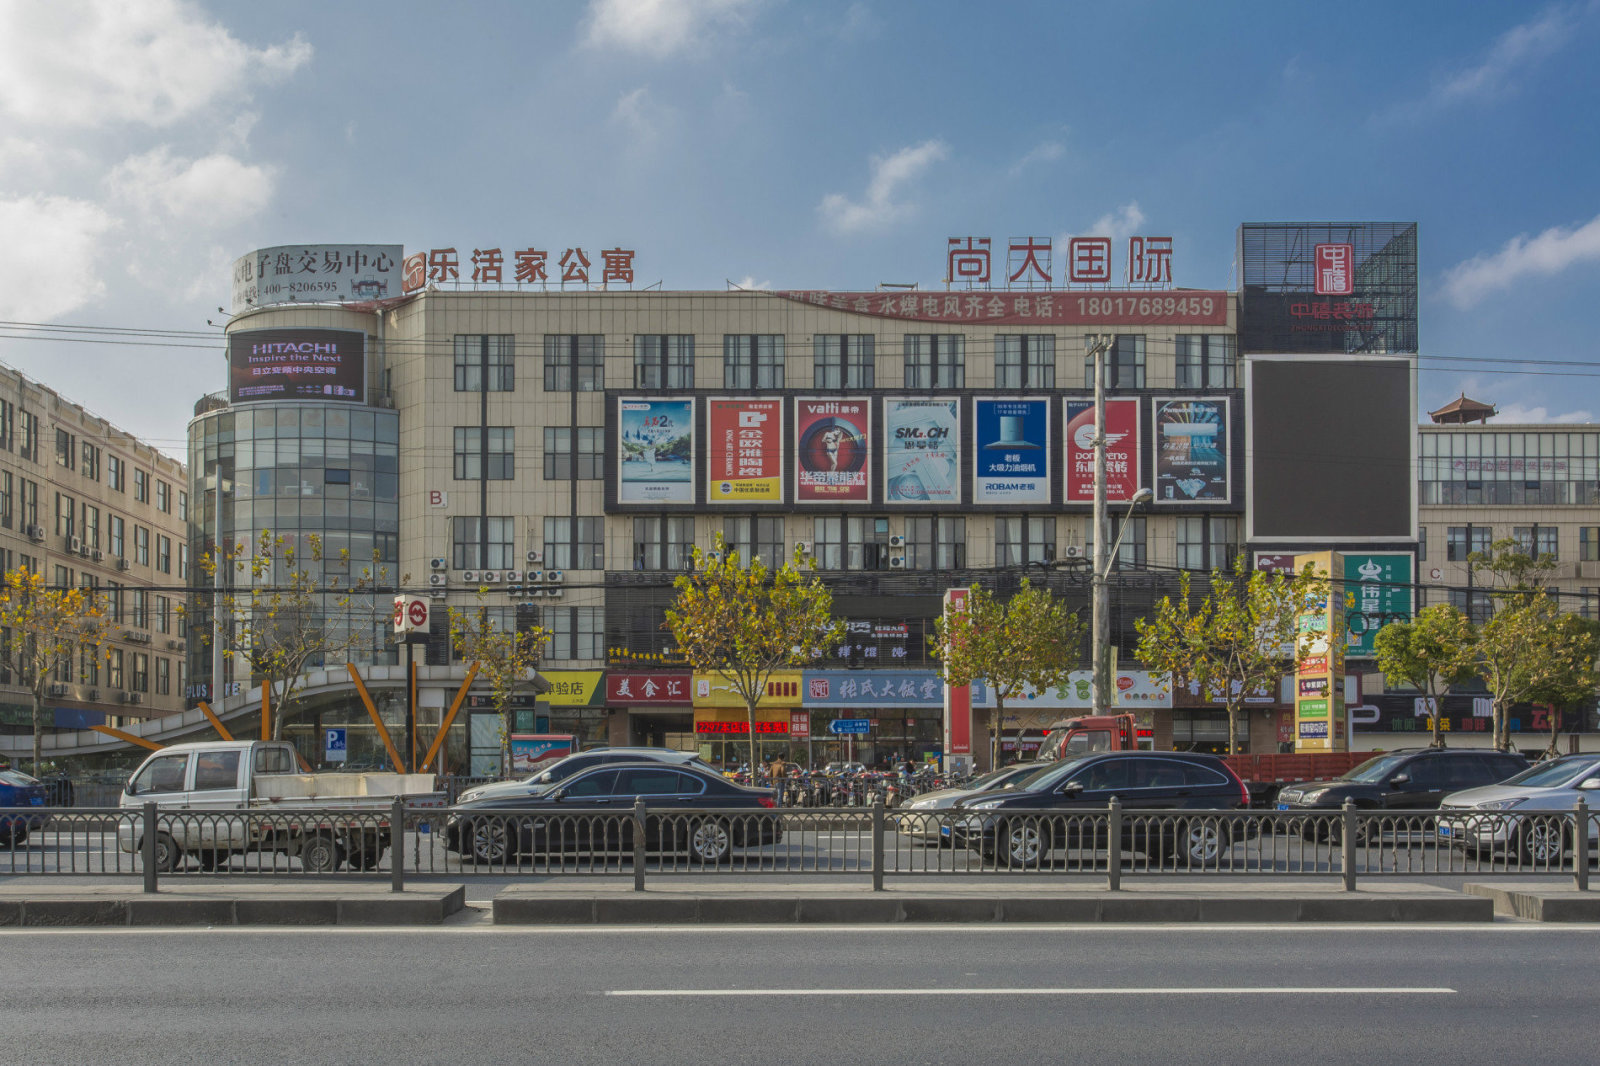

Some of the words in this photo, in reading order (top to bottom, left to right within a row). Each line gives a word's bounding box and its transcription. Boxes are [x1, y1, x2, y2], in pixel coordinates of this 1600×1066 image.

[428, 247, 634, 283] 乐活家公寓
[949, 237, 1172, 282] 尚大国际
[1077, 297, 1214, 316] 18017689459
[252, 342, 337, 354] HITACHI
[248, 354, 285, 363] Inspire
[290, 353, 309, 361] the
[312, 353, 342, 362] Next
[807, 403, 839, 413] vatti
[1075, 452, 1128, 460] DONENG
[989, 463, 1036, 472] 大吸力油烟机
[430, 491, 442, 505] B
[1430, 568, 1441, 580] C
[616, 677, 682, 698] 美食汇
[839, 678, 938, 699] 张氏大饭堂
[327, 731, 338, 749] P
